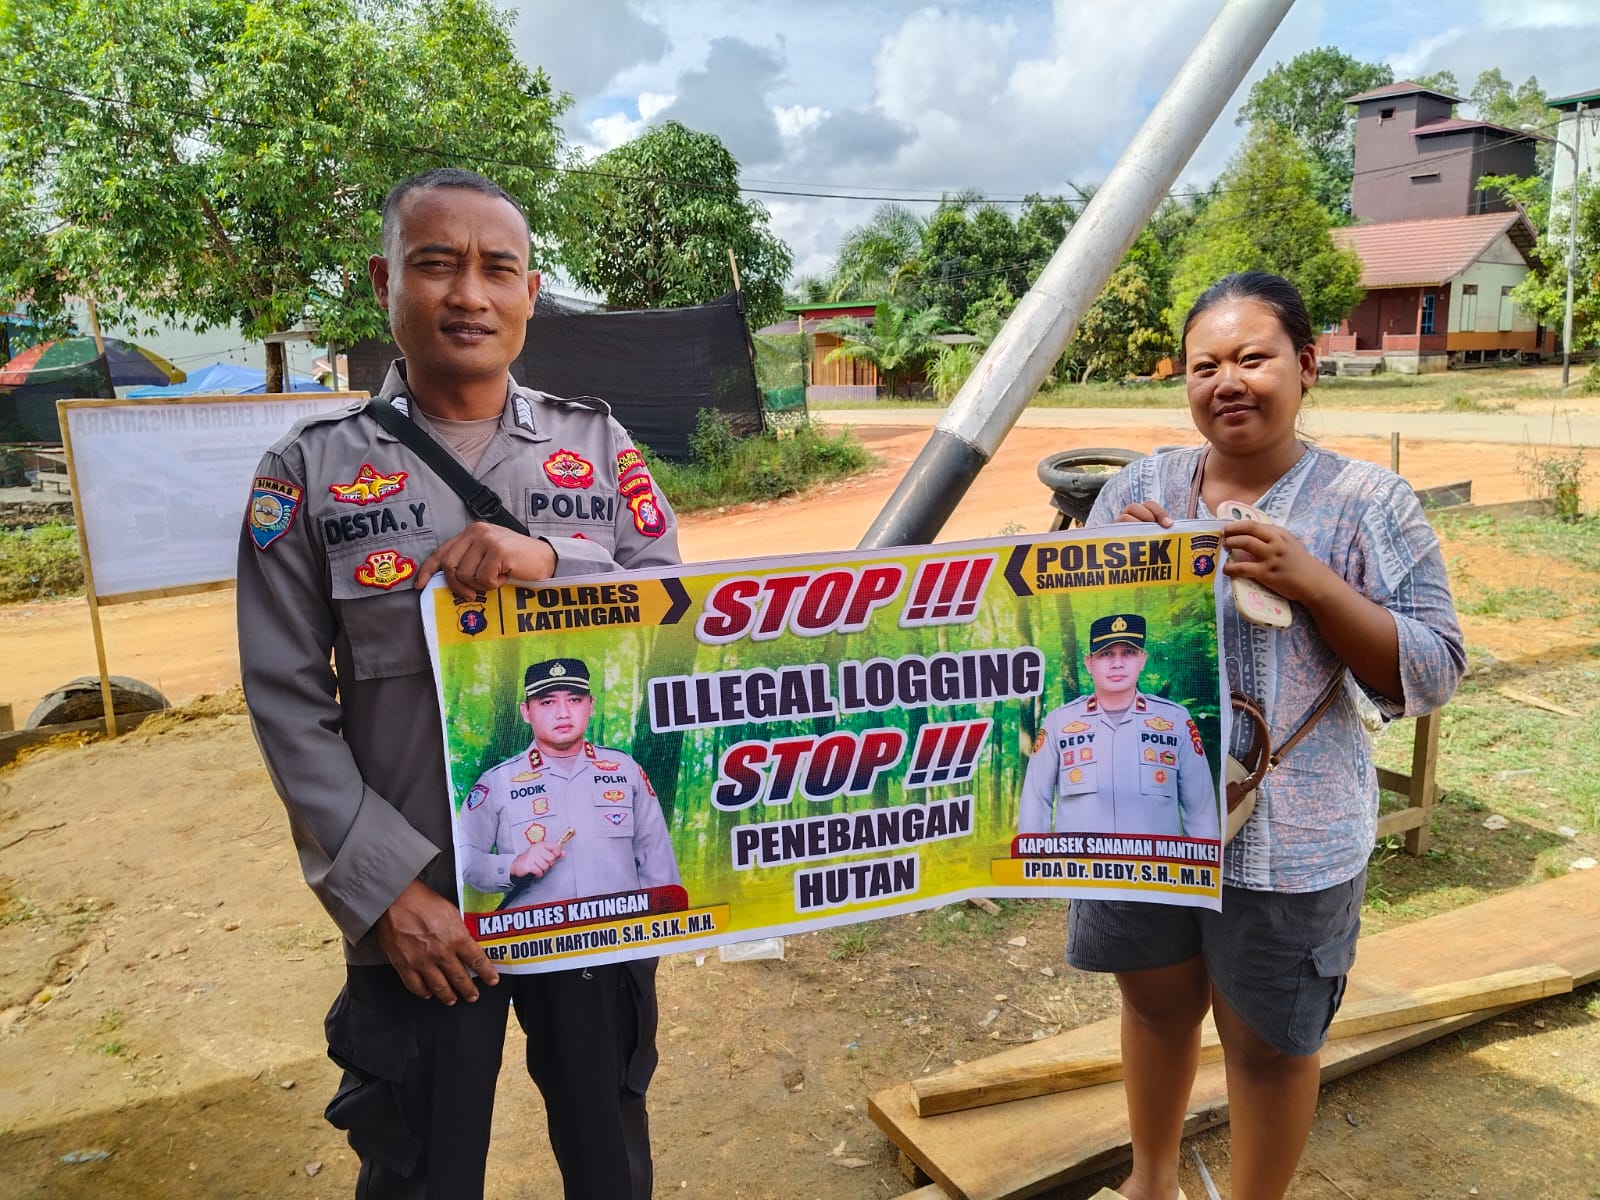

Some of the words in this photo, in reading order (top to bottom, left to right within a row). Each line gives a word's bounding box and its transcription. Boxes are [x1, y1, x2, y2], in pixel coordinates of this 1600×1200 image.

[531, 493, 614, 522] POLRI
[1036, 539, 1173, 572] POLSEK
[1036, 570, 1105, 590] SANAMAN
[1109, 565, 1172, 585] MANTIKEI
[515, 583, 639, 608] POLRES
[701, 566, 902, 638] STOP
[906, 556, 994, 621] !!!
[517, 606, 641, 633] KATINGAN
[653, 668, 833, 728] ILLEGAL
[844, 651, 1041, 707] LOGGING
[1059, 733, 1096, 749] DEDY
[1141, 732, 1177, 747] POLRI
[594, 773, 628, 785] POLRI
[716, 731, 902, 808] STOP
[909, 722, 989, 785] !!!
[510, 783, 546, 801] DODIK
[736, 799, 970, 866] PENEBANGAN
[1018, 837, 1085, 855] KAPOLSEK
[1087, 839, 1154, 857] SANAMAN
[1155, 840, 1219, 862] MANTIKEI
[800, 857, 915, 908] HUTAN
[1024, 861, 1065, 878] IPDA
[1067, 863, 1090, 879] Dr.
[1092, 862, 1138, 883] DEDY,
[1141, 865, 1177, 884] S.H.,
[1180, 868, 1216, 887] M.H.
[478, 905, 565, 935] KAPOLRES
[567, 893, 650, 923] KATINGAN
[510, 938, 556, 960] DODIK
[556, 930, 621, 953] HARTONO,
[622, 924, 650, 945] S.H.,
[687, 913, 715, 933] M.H.
